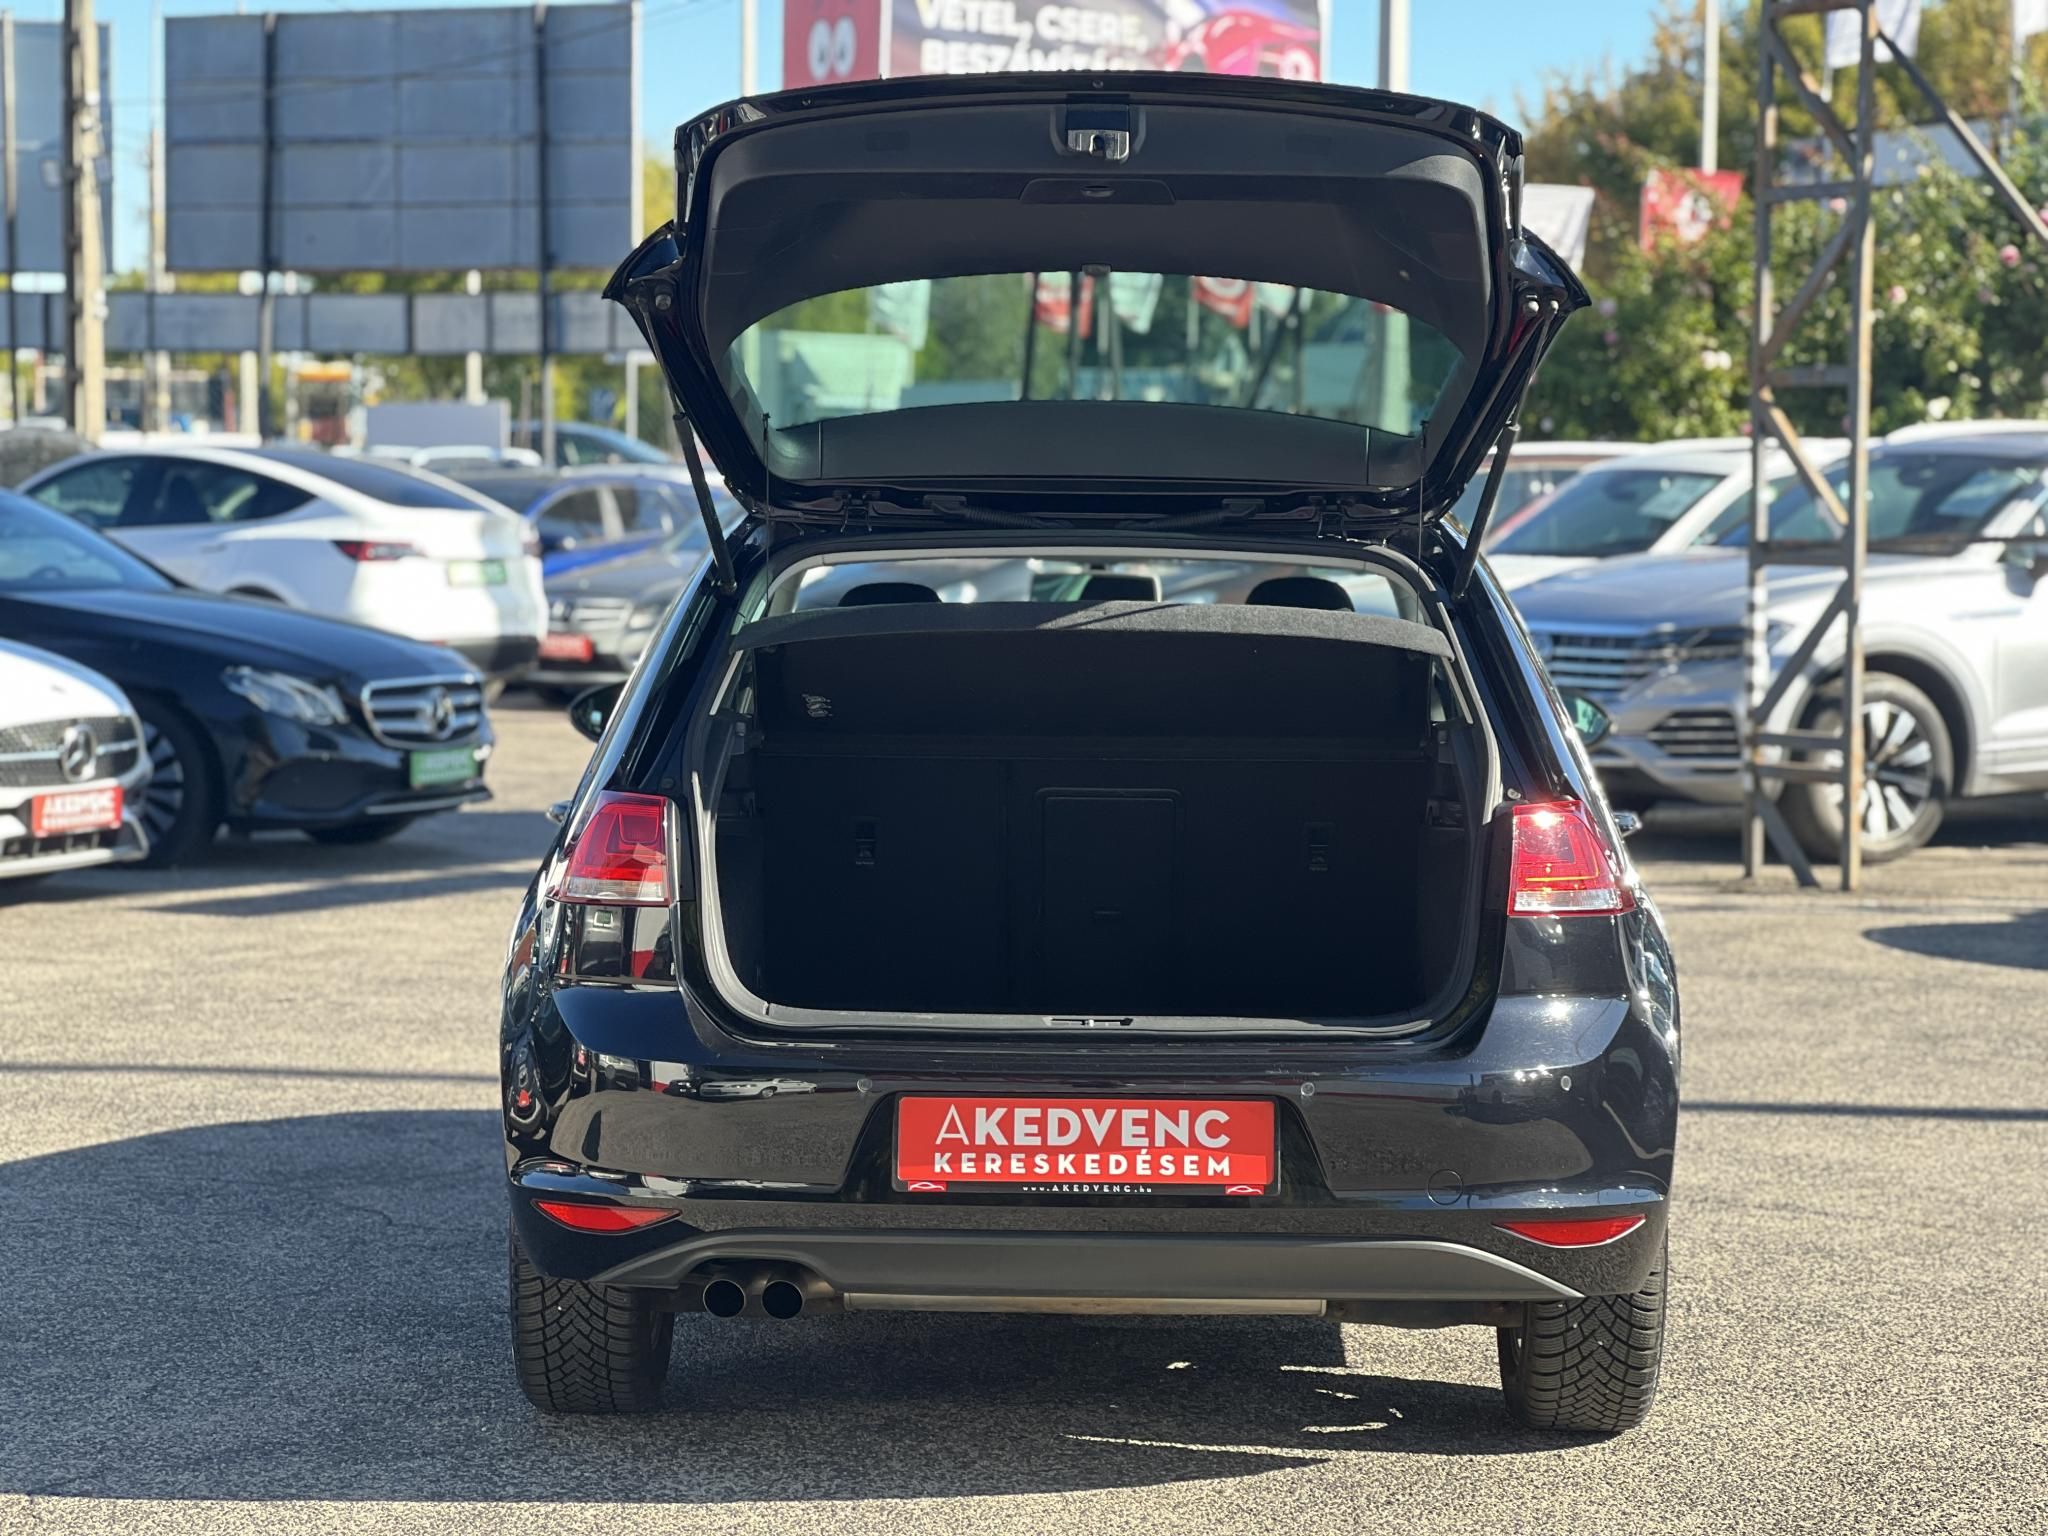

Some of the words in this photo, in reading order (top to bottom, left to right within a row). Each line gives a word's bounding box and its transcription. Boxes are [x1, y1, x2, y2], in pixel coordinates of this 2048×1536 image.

[935, 1104, 1230, 1148] AKEDVENC
[934, 1149, 1230, 1176] KERESKEDÉSEM
[1023, 1184, 1152, 1193] www.AKEDVENC.hu
